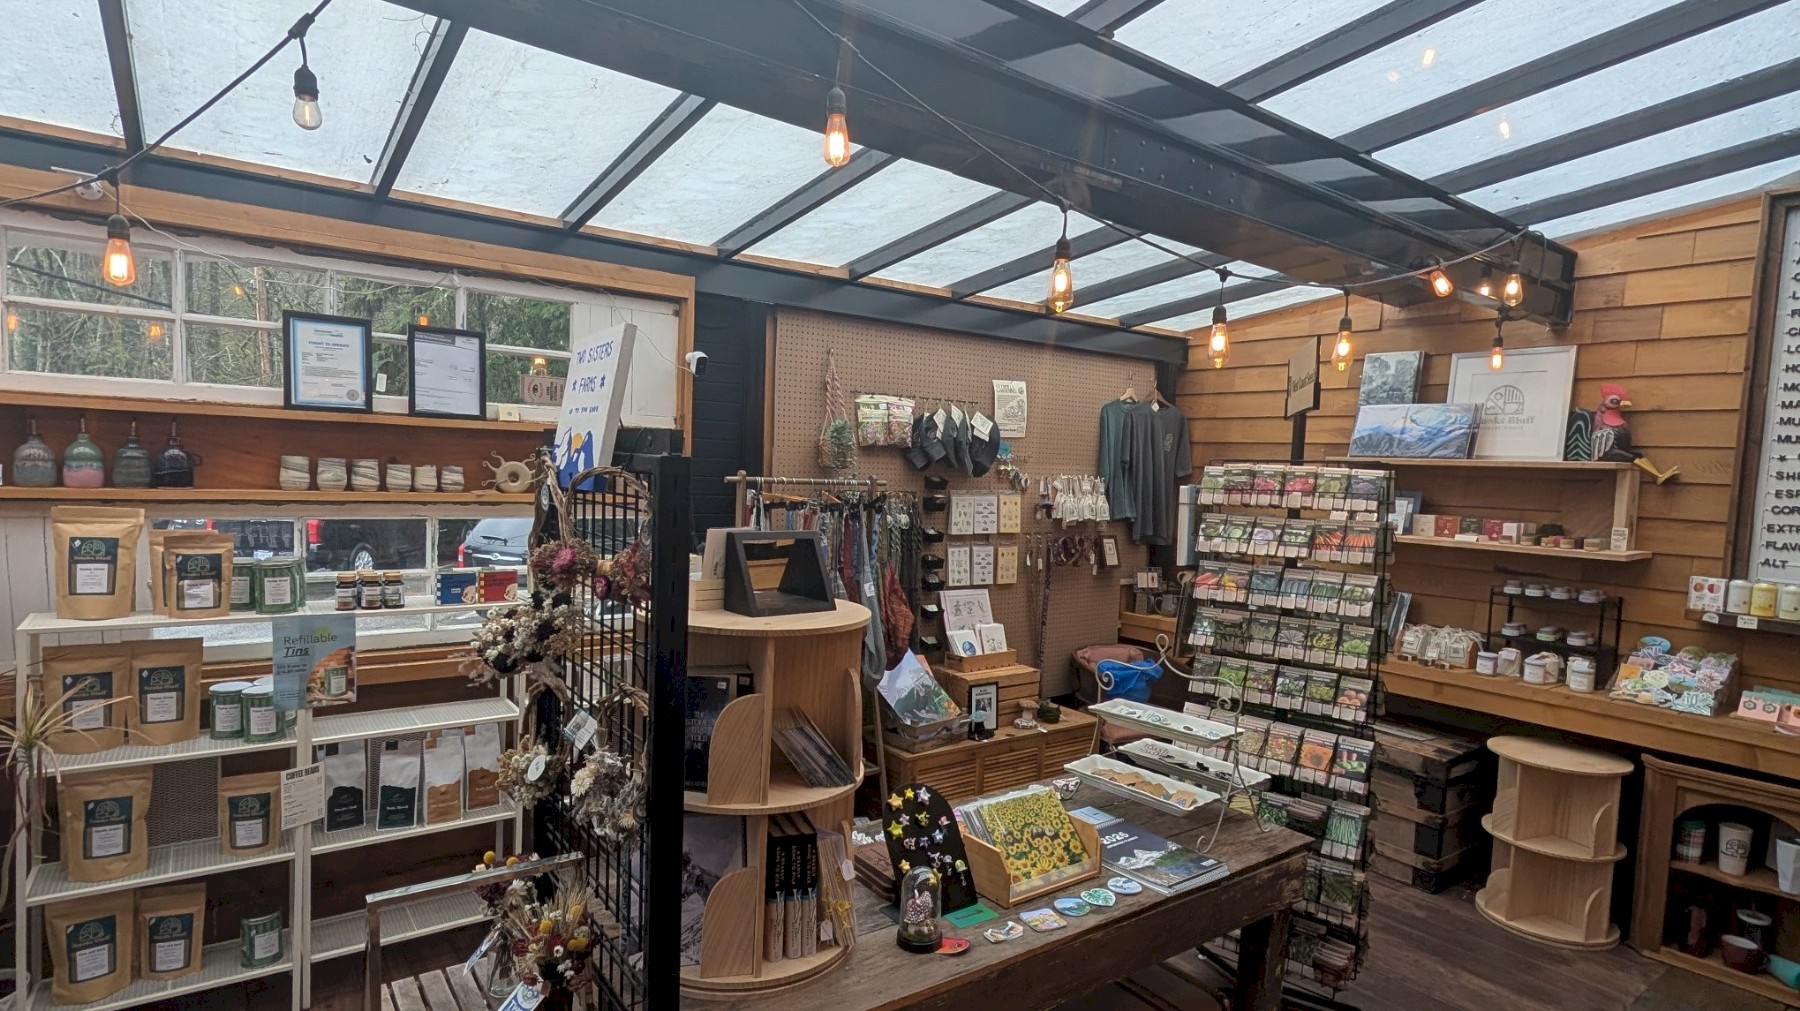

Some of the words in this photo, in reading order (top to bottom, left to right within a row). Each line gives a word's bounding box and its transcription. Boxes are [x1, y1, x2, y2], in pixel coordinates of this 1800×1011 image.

[587, 340, 614, 363] SISTERS
[578, 376, 597, 394] FARMS
[1508, 415, 1535, 424] Bluff
[1761, 558, 1788, 569] ALT
[283, 633, 338, 646] Refillable
[284, 646, 310, 656] Tins
[286, 770, 303, 780] COFFEE
[304, 766, 320, 776] BEANS
